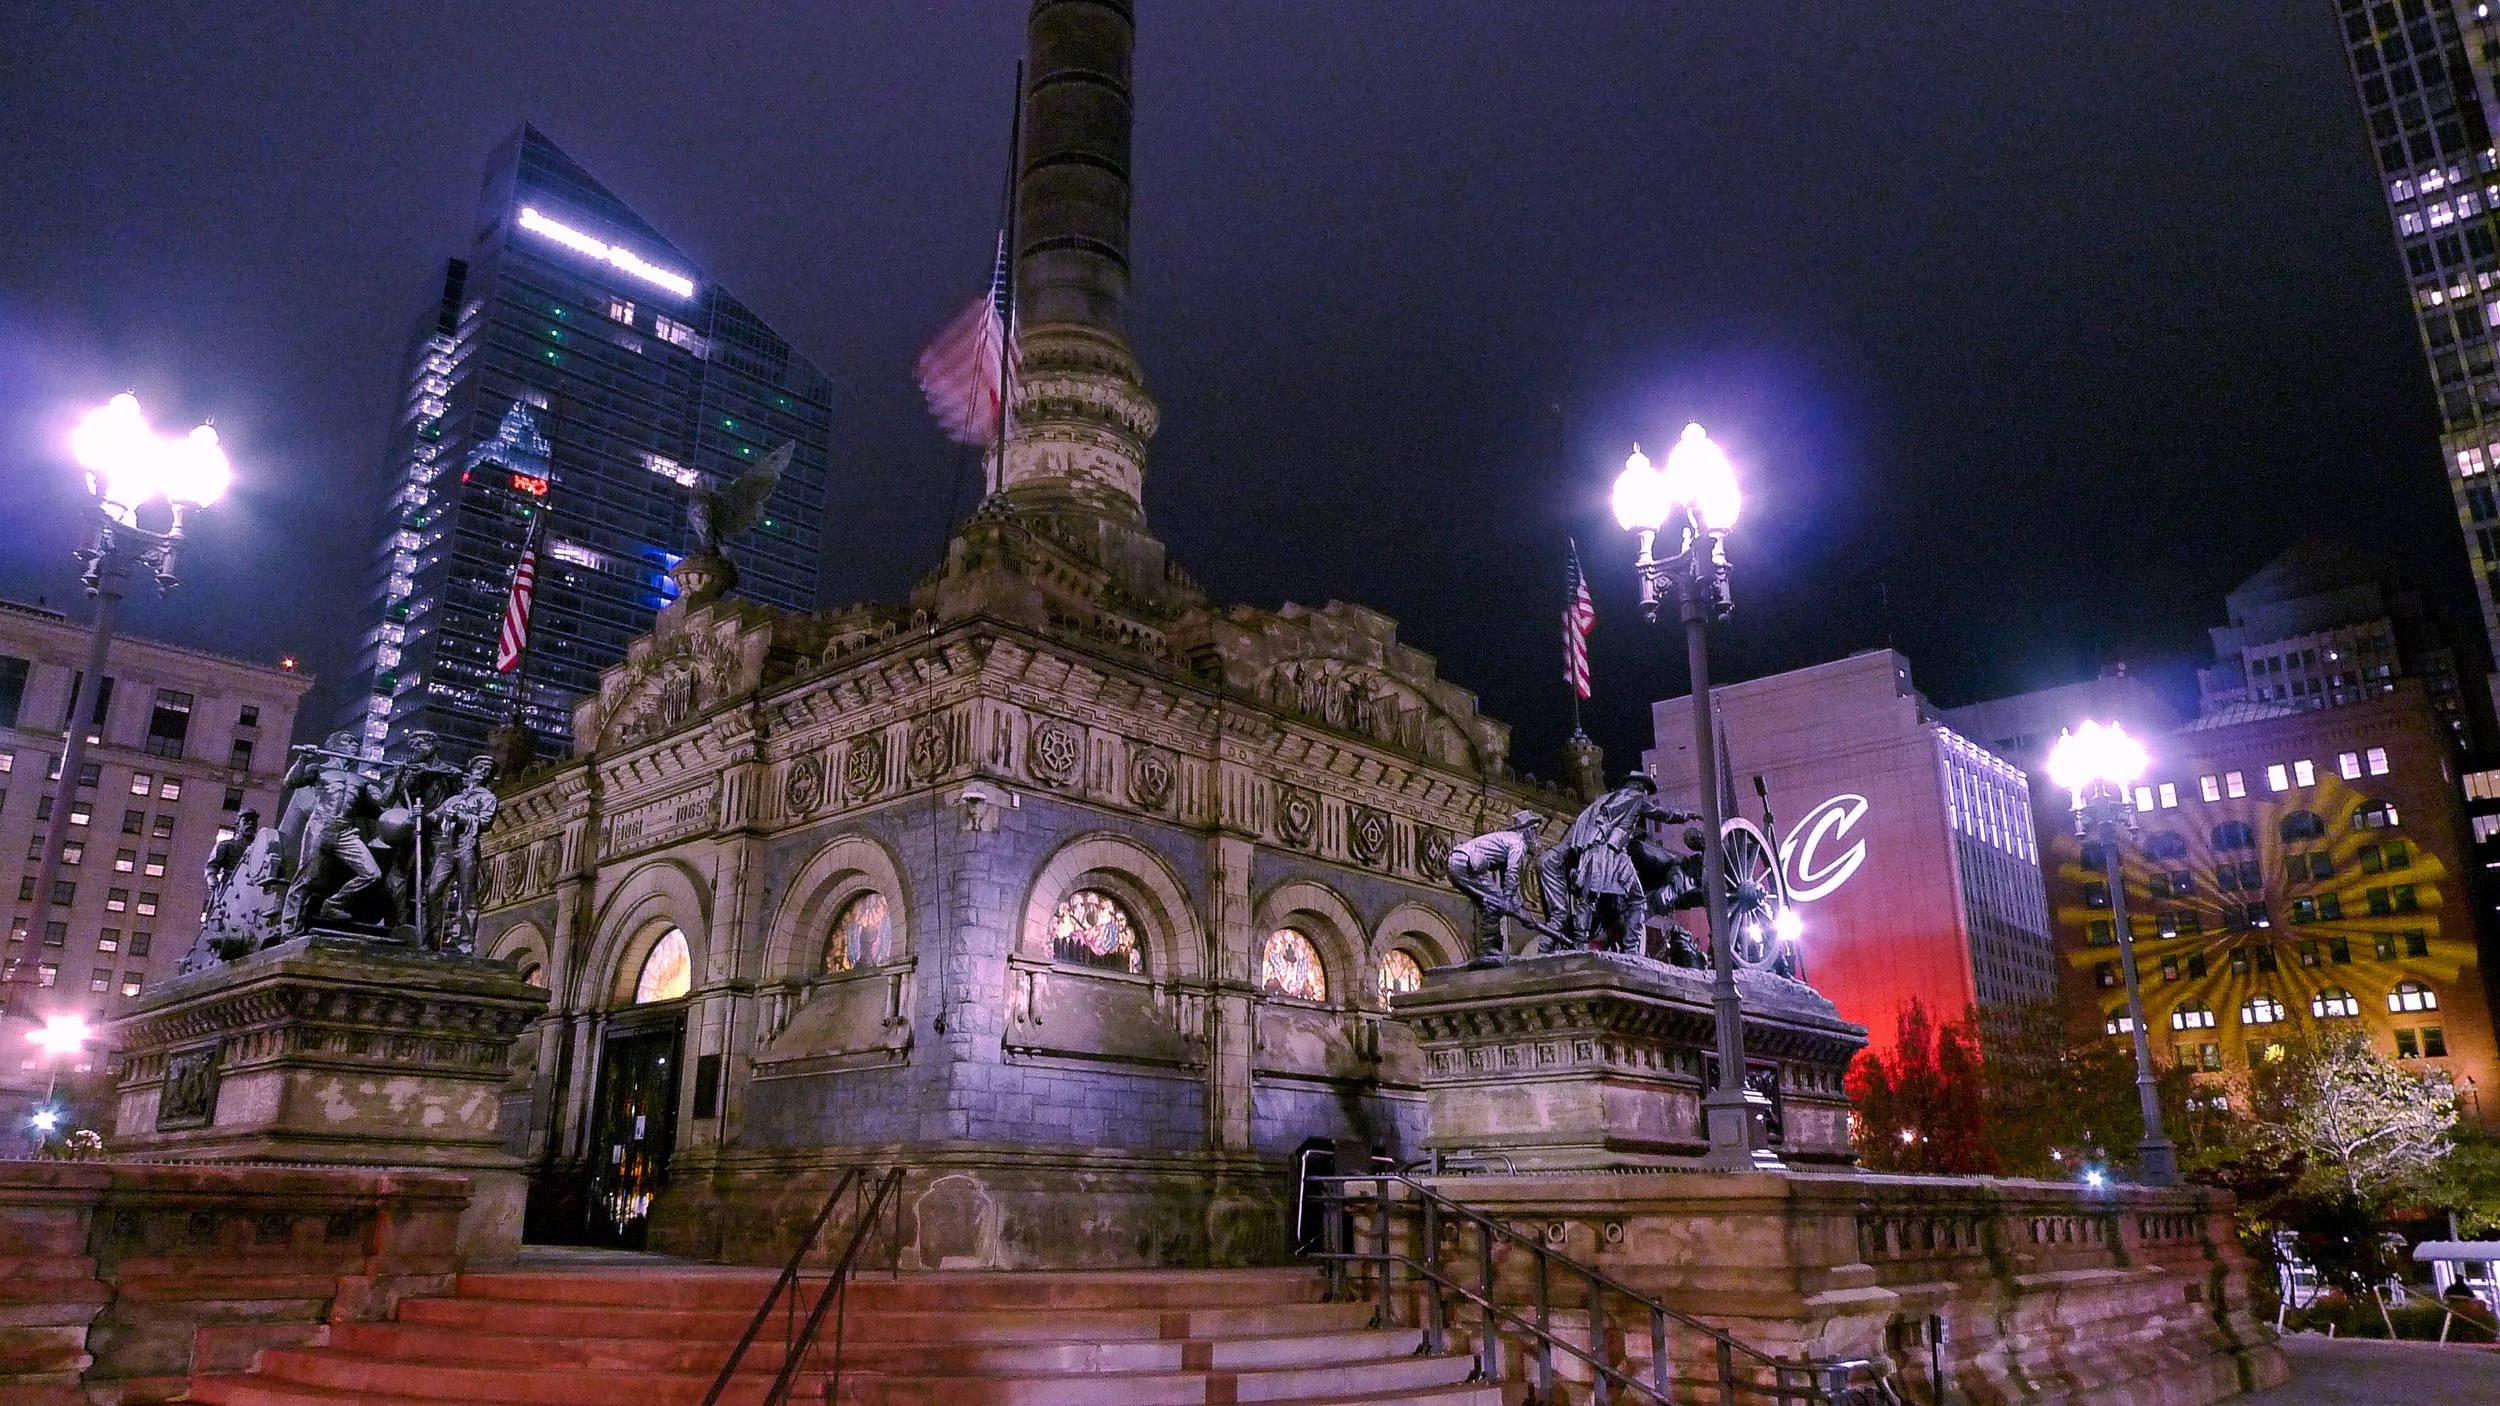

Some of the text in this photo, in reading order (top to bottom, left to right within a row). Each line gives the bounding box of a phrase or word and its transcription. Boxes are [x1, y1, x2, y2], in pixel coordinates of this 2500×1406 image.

[620, 801, 703, 841] 1861 1865
[1780, 793, 1869, 902] C
